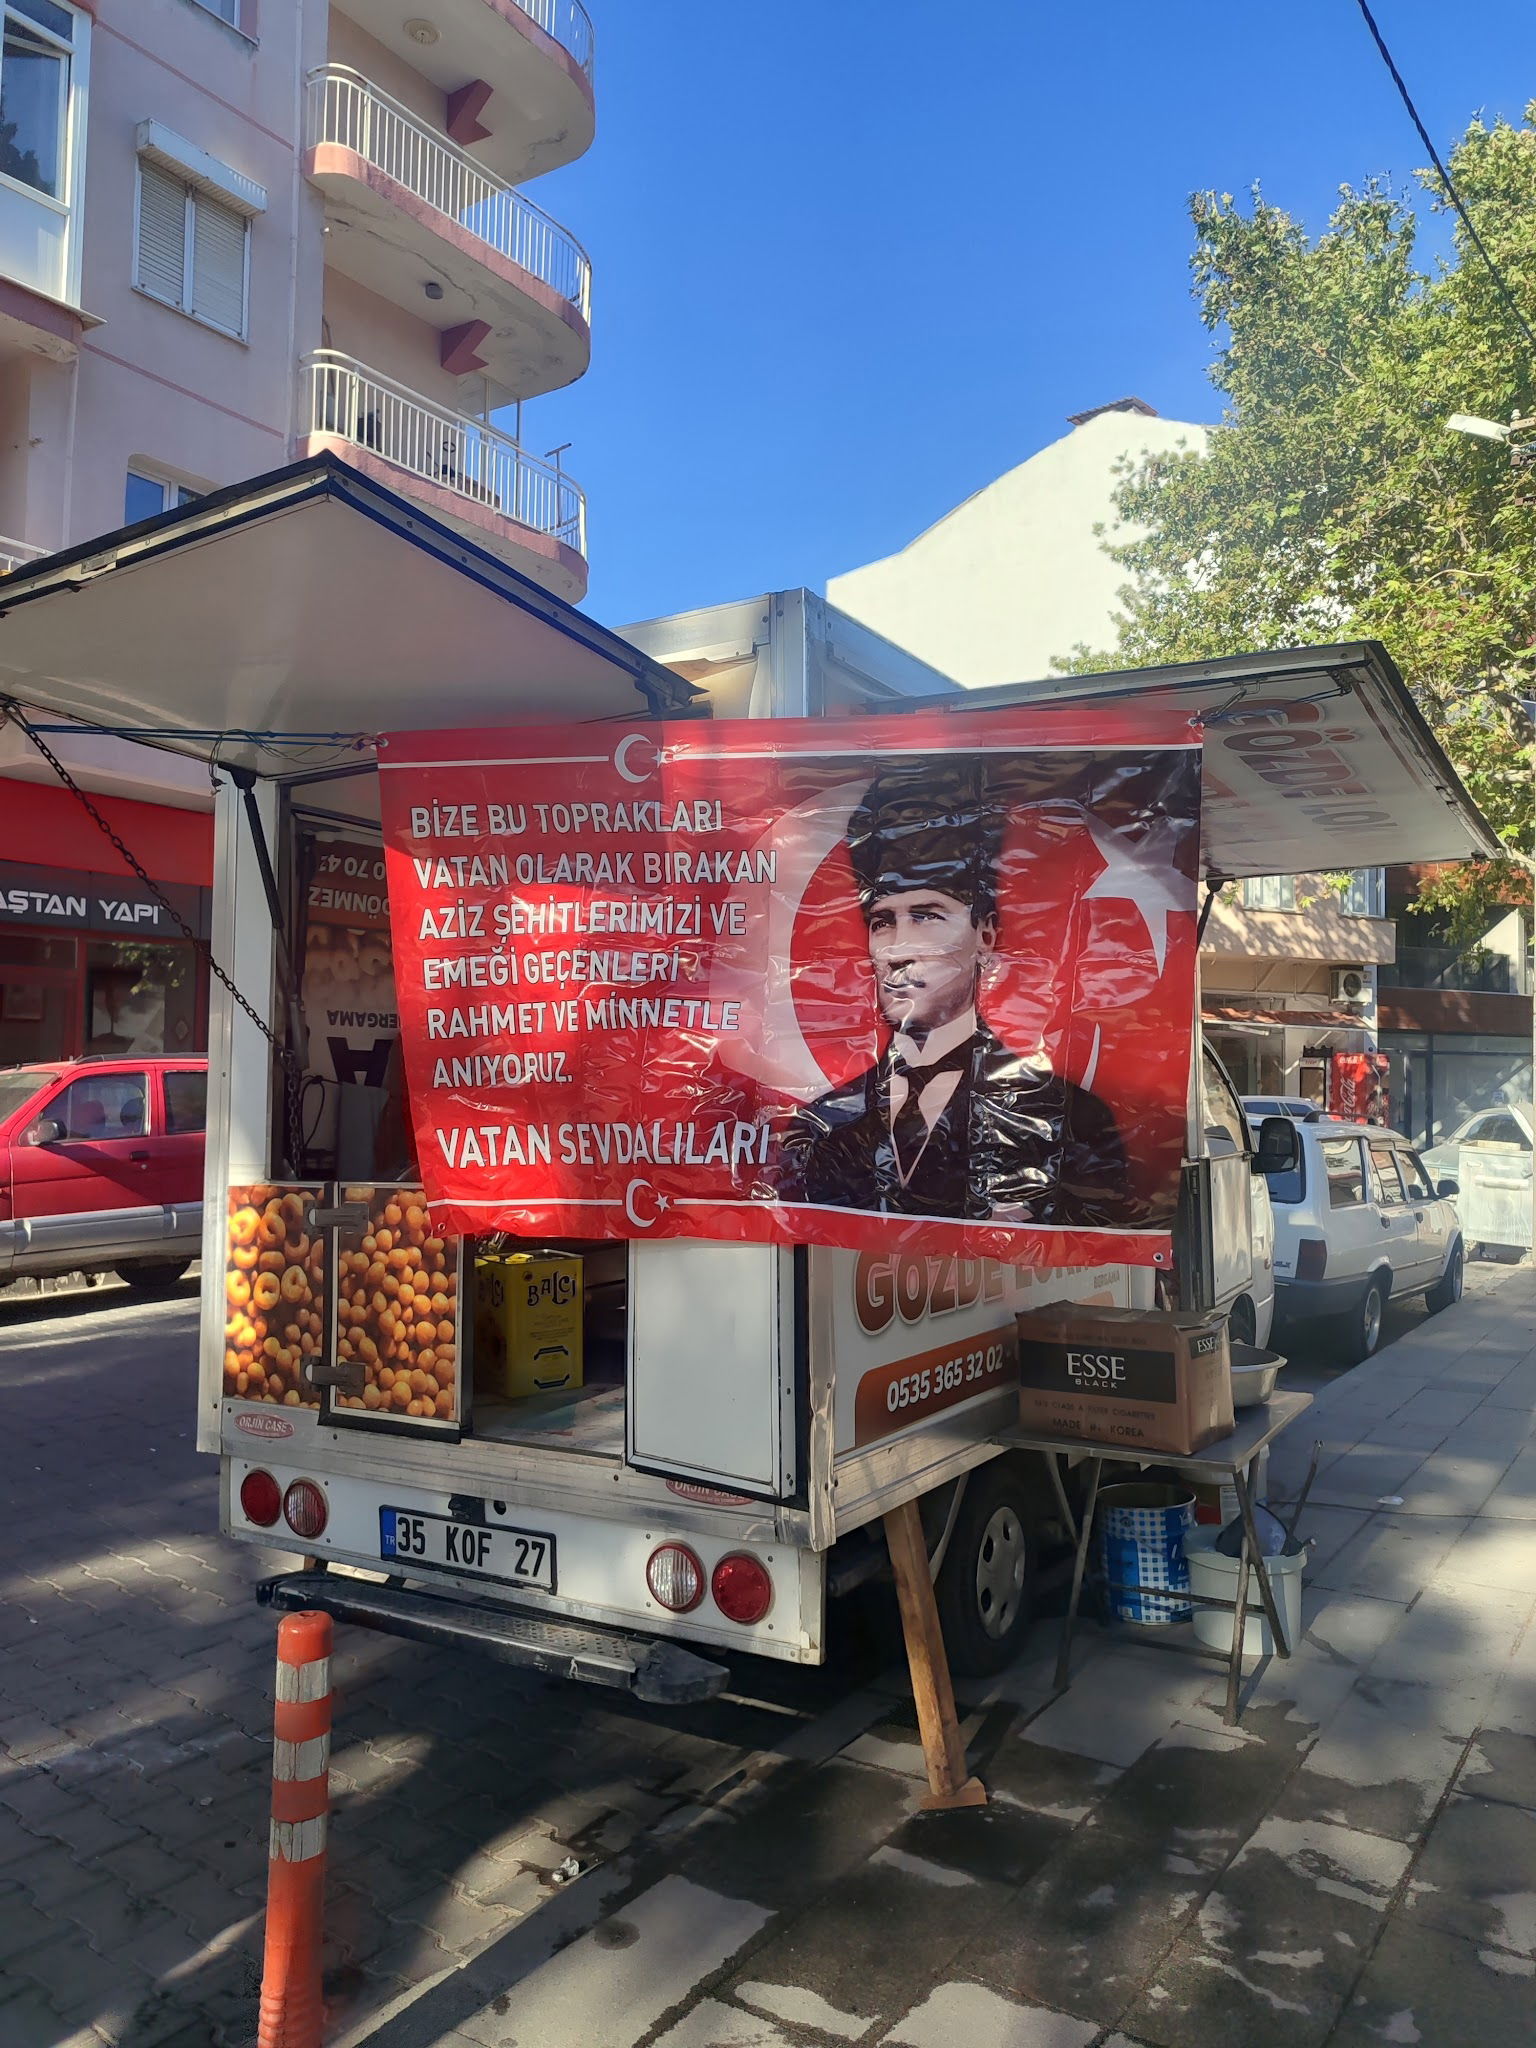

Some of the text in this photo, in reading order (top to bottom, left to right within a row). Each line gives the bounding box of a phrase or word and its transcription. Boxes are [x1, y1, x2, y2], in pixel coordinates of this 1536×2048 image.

[411, 798, 723, 838] BİZE BU TOPRAKLARI
[344, 856, 369, 878] 70
[412, 850, 777, 889] VATAN OLARAK BIRAKAN
[98, 899, 159, 925] YAPI
[418, 894, 747, 944] AZİZ ŞEHİTLERİMİZİ VE
[422, 945, 680, 990] EMEĞİ GEÇENLERİ
[327, 1010, 401, 1029] ERGAMA
[427, 991, 741, 1040] RAHMET VE MİNNETLE
[433, 1051, 573, 1089] ANIYORUZ.
[436, 1121, 771, 1169] VATAN SEVDALILARI
[886, 1344, 1003, 1413] 0535 365 32 02
[1066, 1352, 1126, 1381] ESSE
[1075, 1378, 1118, 1389] BLACK
[1110, 1425, 1145, 1437] KOREA
[385, 1534, 396, 1545] TR
[397, 1516, 546, 1578] 35 KOF 27
